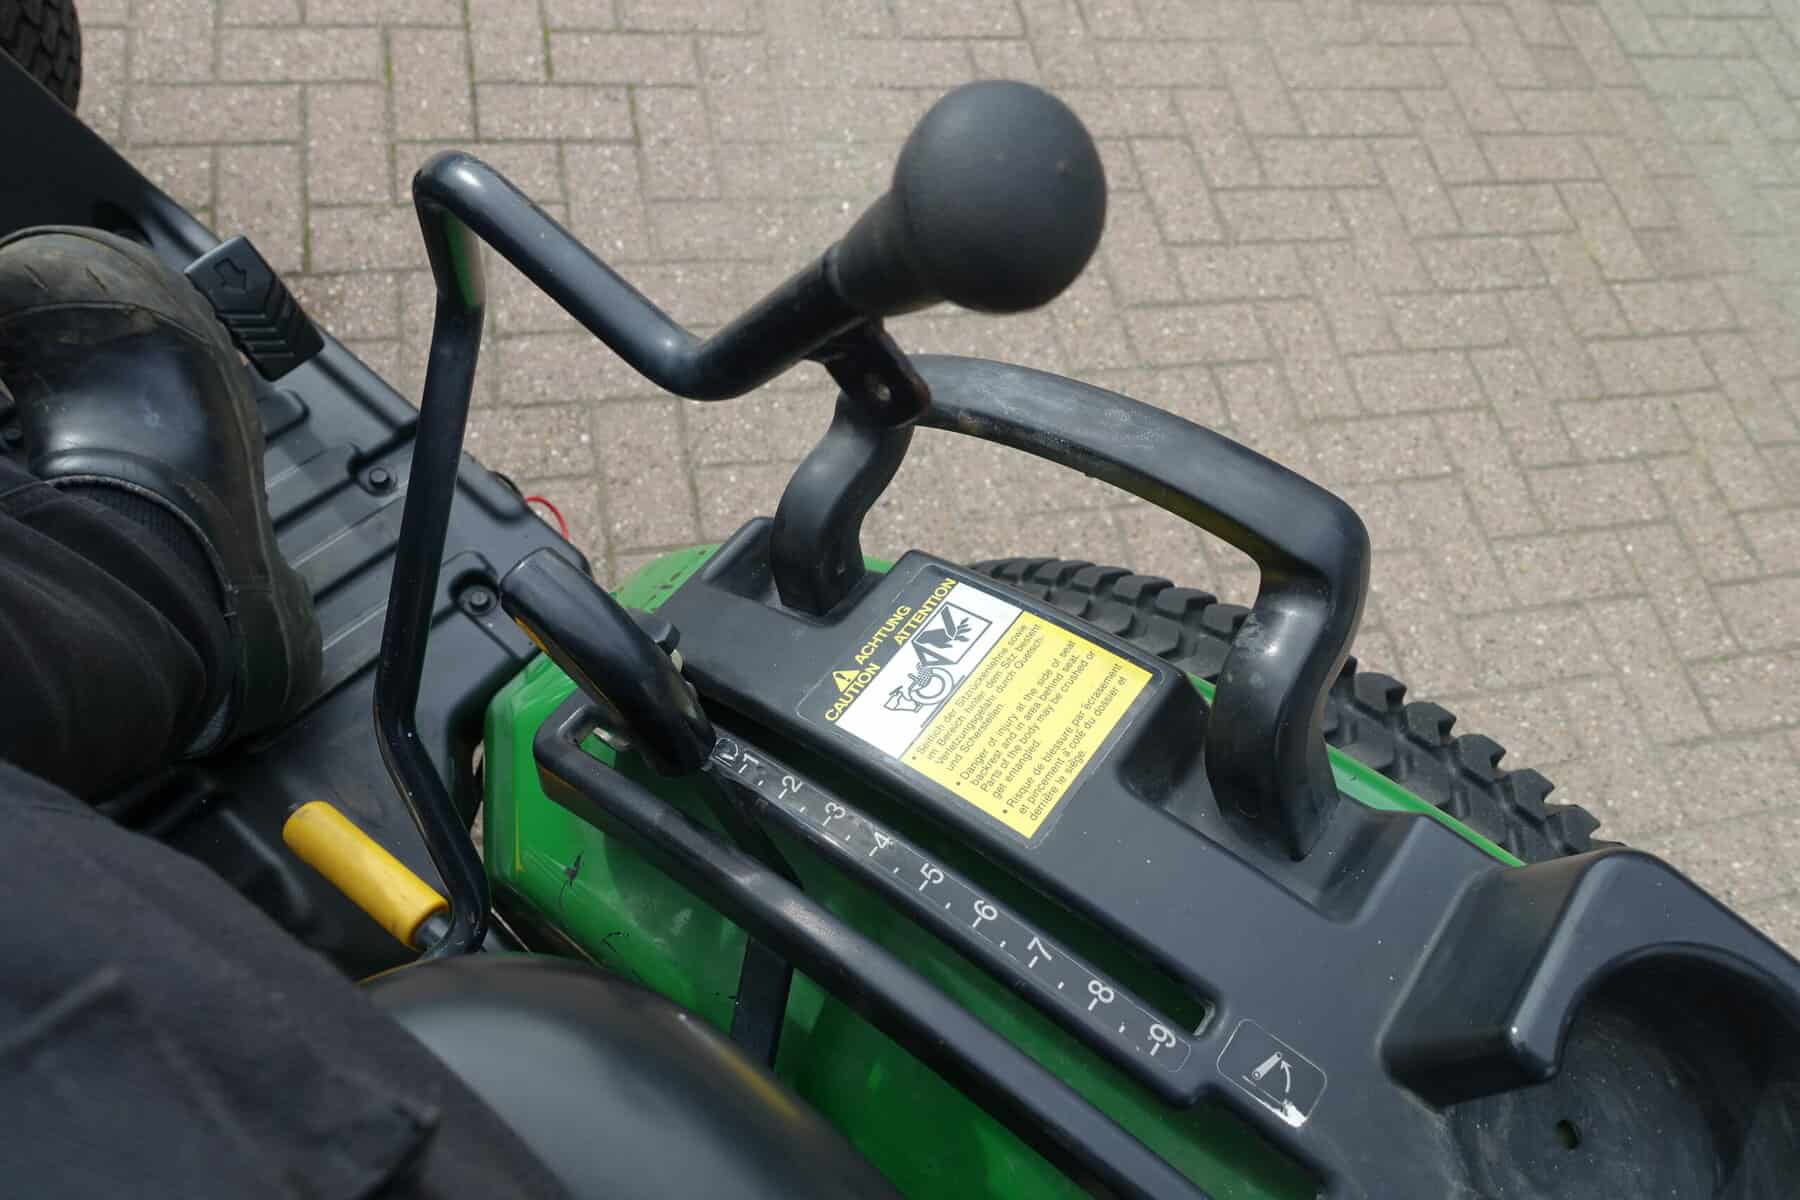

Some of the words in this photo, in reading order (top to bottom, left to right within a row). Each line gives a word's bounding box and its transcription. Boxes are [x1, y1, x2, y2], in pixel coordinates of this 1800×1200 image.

[855, 605, 912, 665] ACHTUNG
[825, 662, 881, 721] CAUTION
[894, 577, 957, 645] ATTENTION
[958, 746, 992, 782] Danger
[985, 736, 998, 748] of
[994, 712, 1020, 737] injury
[1014, 702, 1026, 712] at
[1021, 686, 1038, 702] the
[1034, 667, 1053, 687] side
[1048, 657, 1061, 668] of
[1057, 639, 1076, 658] seat
[979, 767, 1003, 792] Parts
[997, 757, 1011, 769] of
[1005, 742, 1023, 759] the
[1017, 722, 1041, 745] body
[1035, 703, 1056, 724] may
[1048, 690, 1064, 705] be
[1057, 659, 1089, 693] crushed
[1085, 650, 1096, 660] or
[969, 749, 1003, 787] backrest
[999, 730, 1018, 749] and
[1014, 721, 1025, 731] in
[1022, 701, 1042, 721] area
[1037, 672, 1064, 701] behind
[1017, 803, 1029, 815] et
[1026, 757, 1066, 804] pincement
[1081, 716, 1096, 729] du
[1090, 685, 1119, 717] dossier
[1115, 675, 1127, 686] et
[944, 753, 963, 771] und
[1005, 774, 1037, 809] Risque
[1030, 761, 1046, 776] de
[1040, 725, 1074, 762] blessure
[1070, 710, 1088, 727] par
[782, 775, 803, 792] 2
[991, 782, 1009, 800] get
[1054, 774, 1067, 785] le
[825, 802, 846, 819] 3
[874, 832, 892, 848] 4
[920, 863, 944, 884] 5
[974, 900, 997, 920] 6
[1027, 936, 1052, 961] 7
[1088, 980, 1114, 1003] 8
[1150, 1023, 1176, 1048] 9
